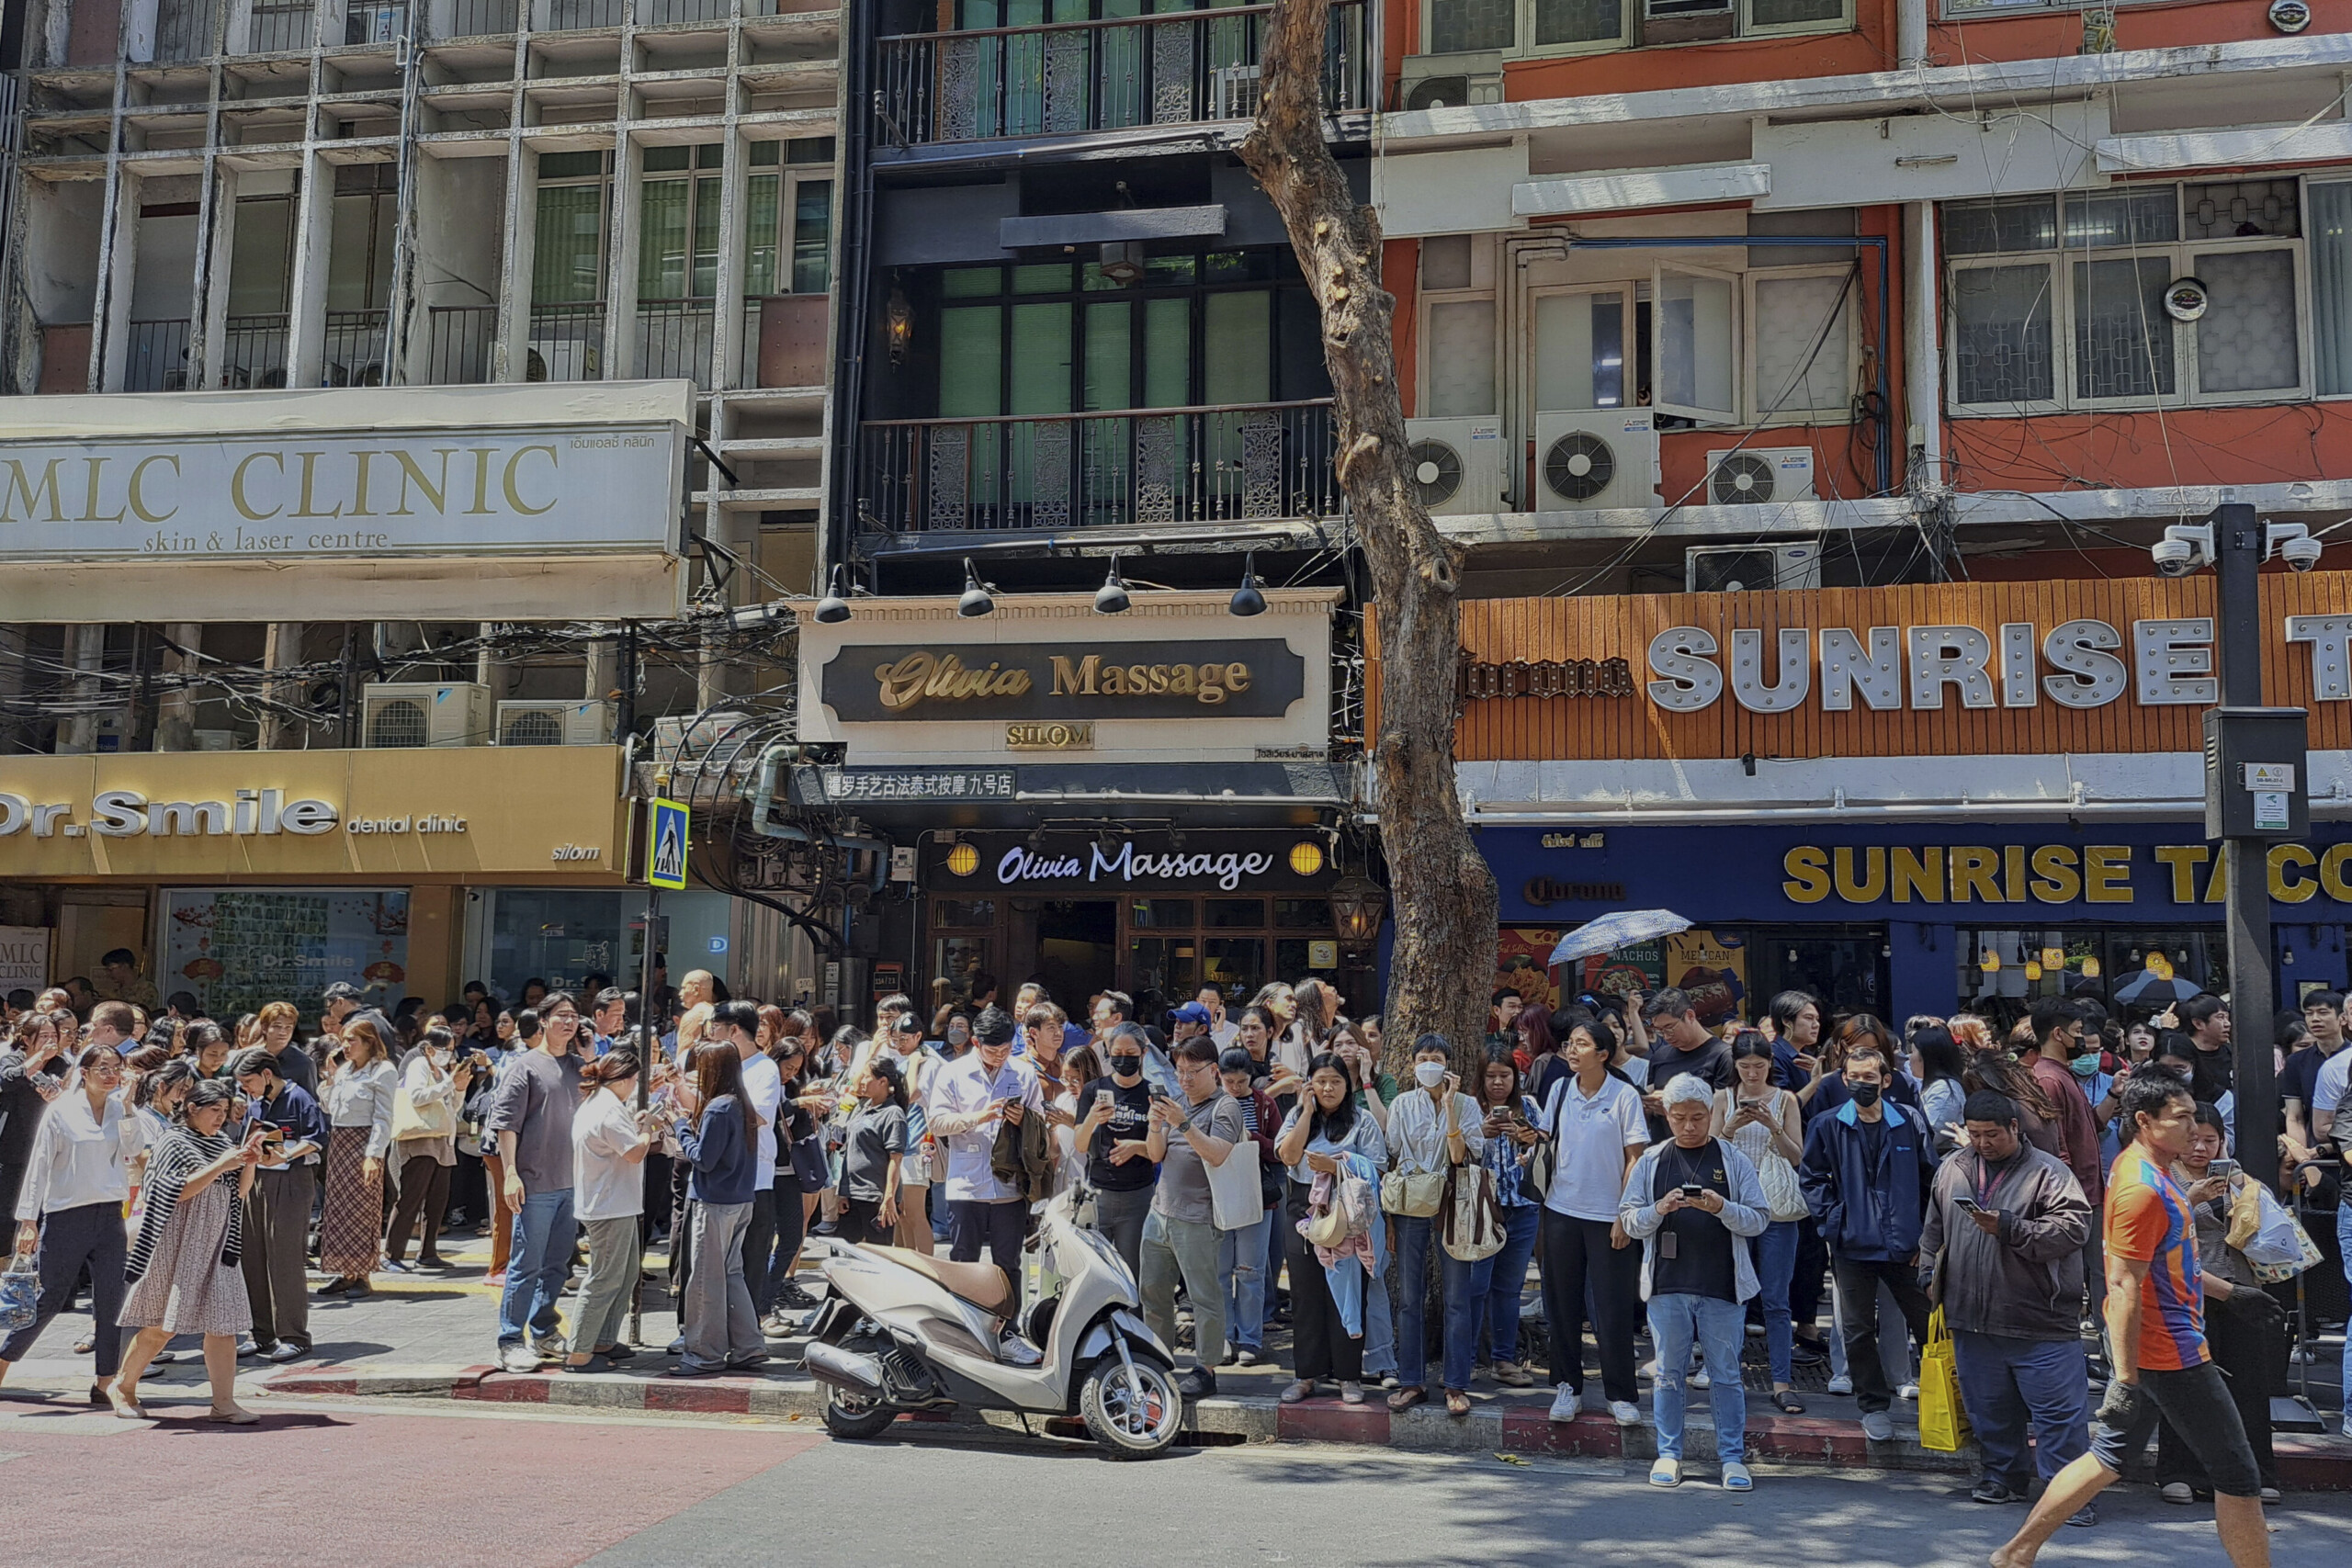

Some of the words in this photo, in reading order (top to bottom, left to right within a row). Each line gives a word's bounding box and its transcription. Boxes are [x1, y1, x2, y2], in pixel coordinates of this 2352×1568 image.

[624, 435, 654, 447] คลินิก
[0, 454, 180, 524] MLC
[232, 445, 559, 521] CLINIC
[143, 530, 197, 552] skin
[206, 531, 224, 551] &
[234, 526, 293, 551] laser
[308, 530, 388, 549] centre
[1647, 617, 2218, 713] SUNRISE
[875, 651, 1032, 710] Olivia
[1048, 655, 1250, 705] Massage
[1006, 724, 1091, 747] SILOM
[969, 774, 1012, 795] 九号店
[346, 815, 413, 834] dental
[416, 814, 467, 833] clinic
[551, 843, 600, 862] silom
[997, 846, 1082, 885] Olivia
[1089, 841, 1273, 891] Massage
[1782, 844, 2134, 904] SUNRISE
[0, 943, 42, 964] MLC
[263, 954, 355, 967] Dr.Smile
[1612, 951, 1658, 962] NACHOS
[0, 965, 42, 979] CLINIC
